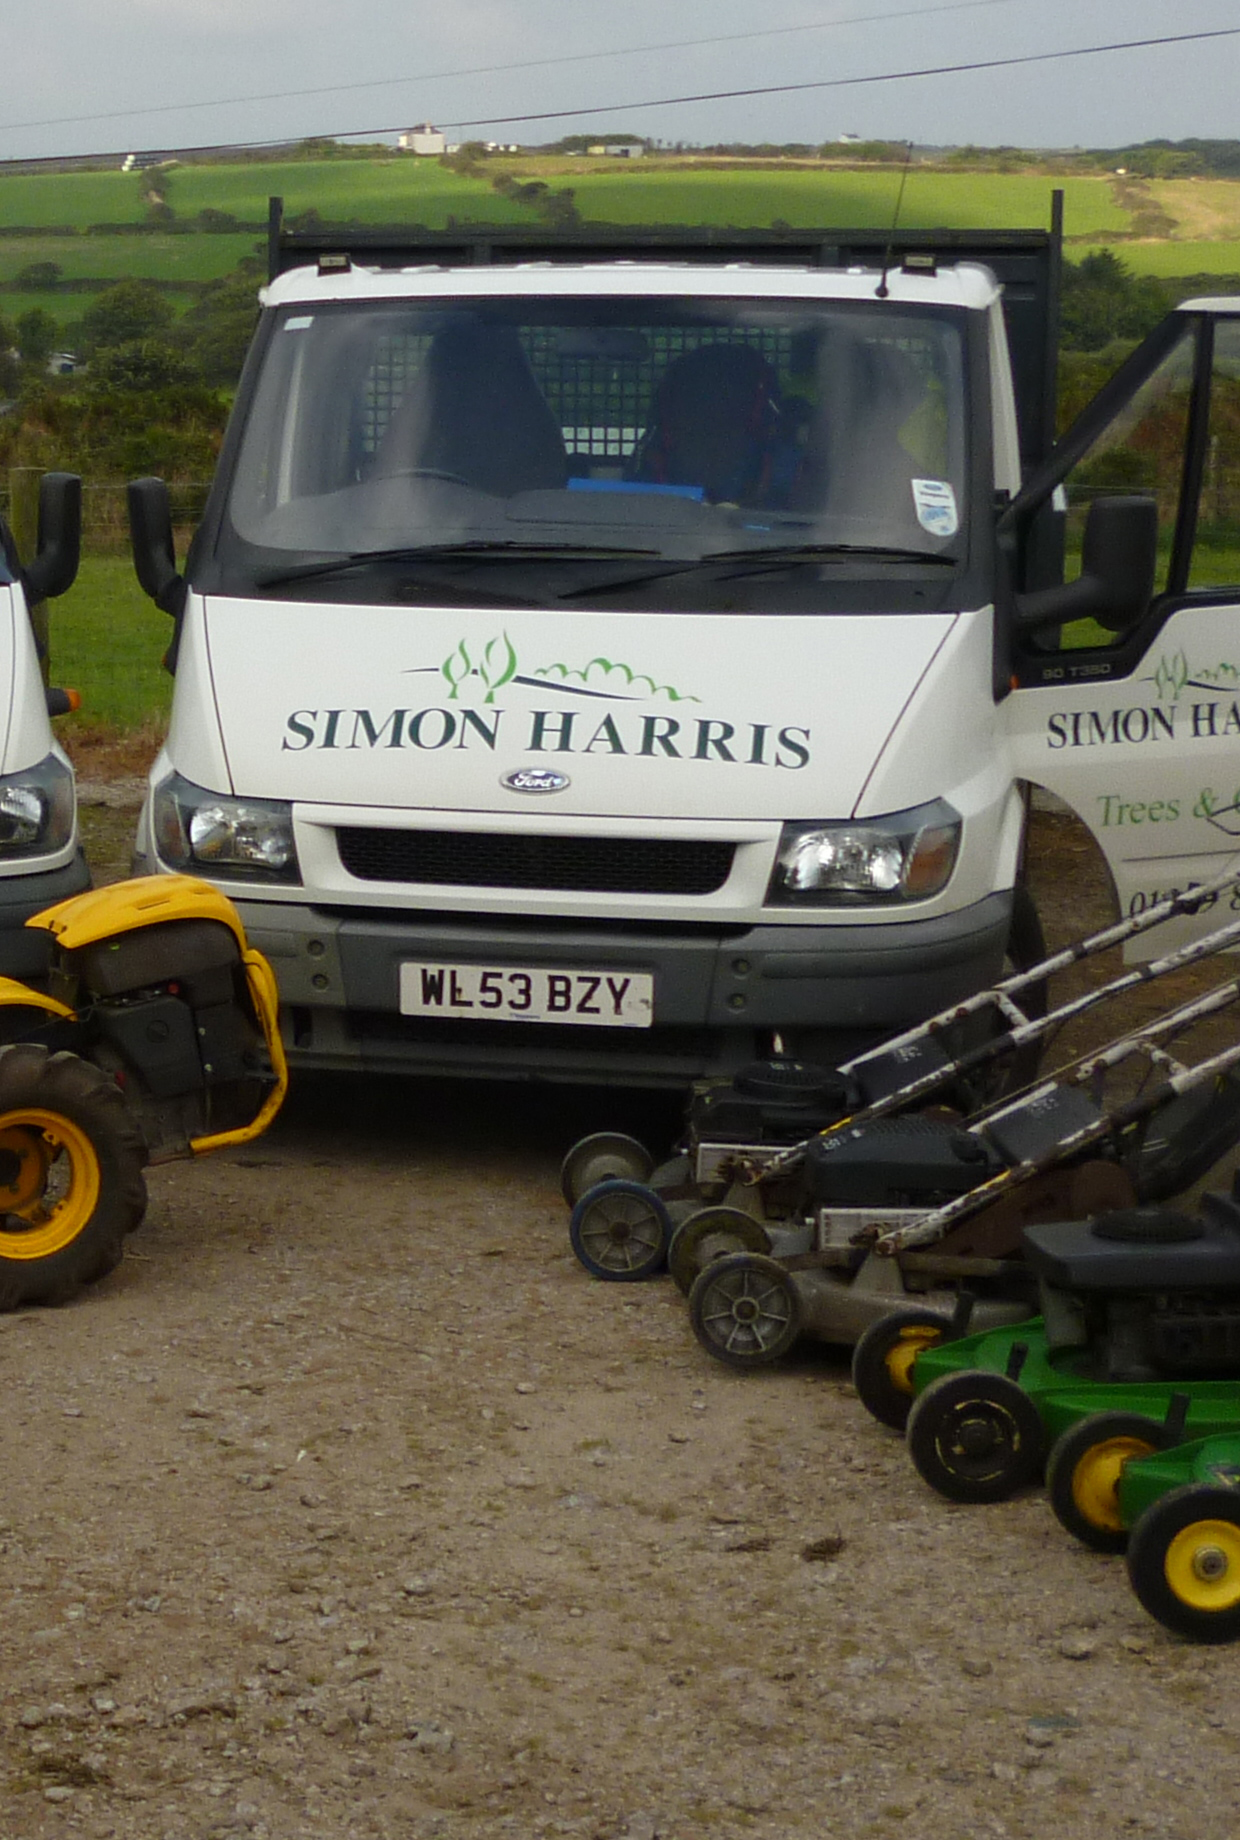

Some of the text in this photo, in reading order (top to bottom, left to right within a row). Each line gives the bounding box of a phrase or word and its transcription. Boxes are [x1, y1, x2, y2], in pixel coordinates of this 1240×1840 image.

[281, 707, 811, 769] SIMON HARRIS
[1047, 705, 1177, 748] SIMON
[514, 771, 554, 787] Ford
[1097, 795, 1180, 826] Trees
[1193, 787, 1219, 818] &
[421, 968, 630, 1015] WL53 BZY
